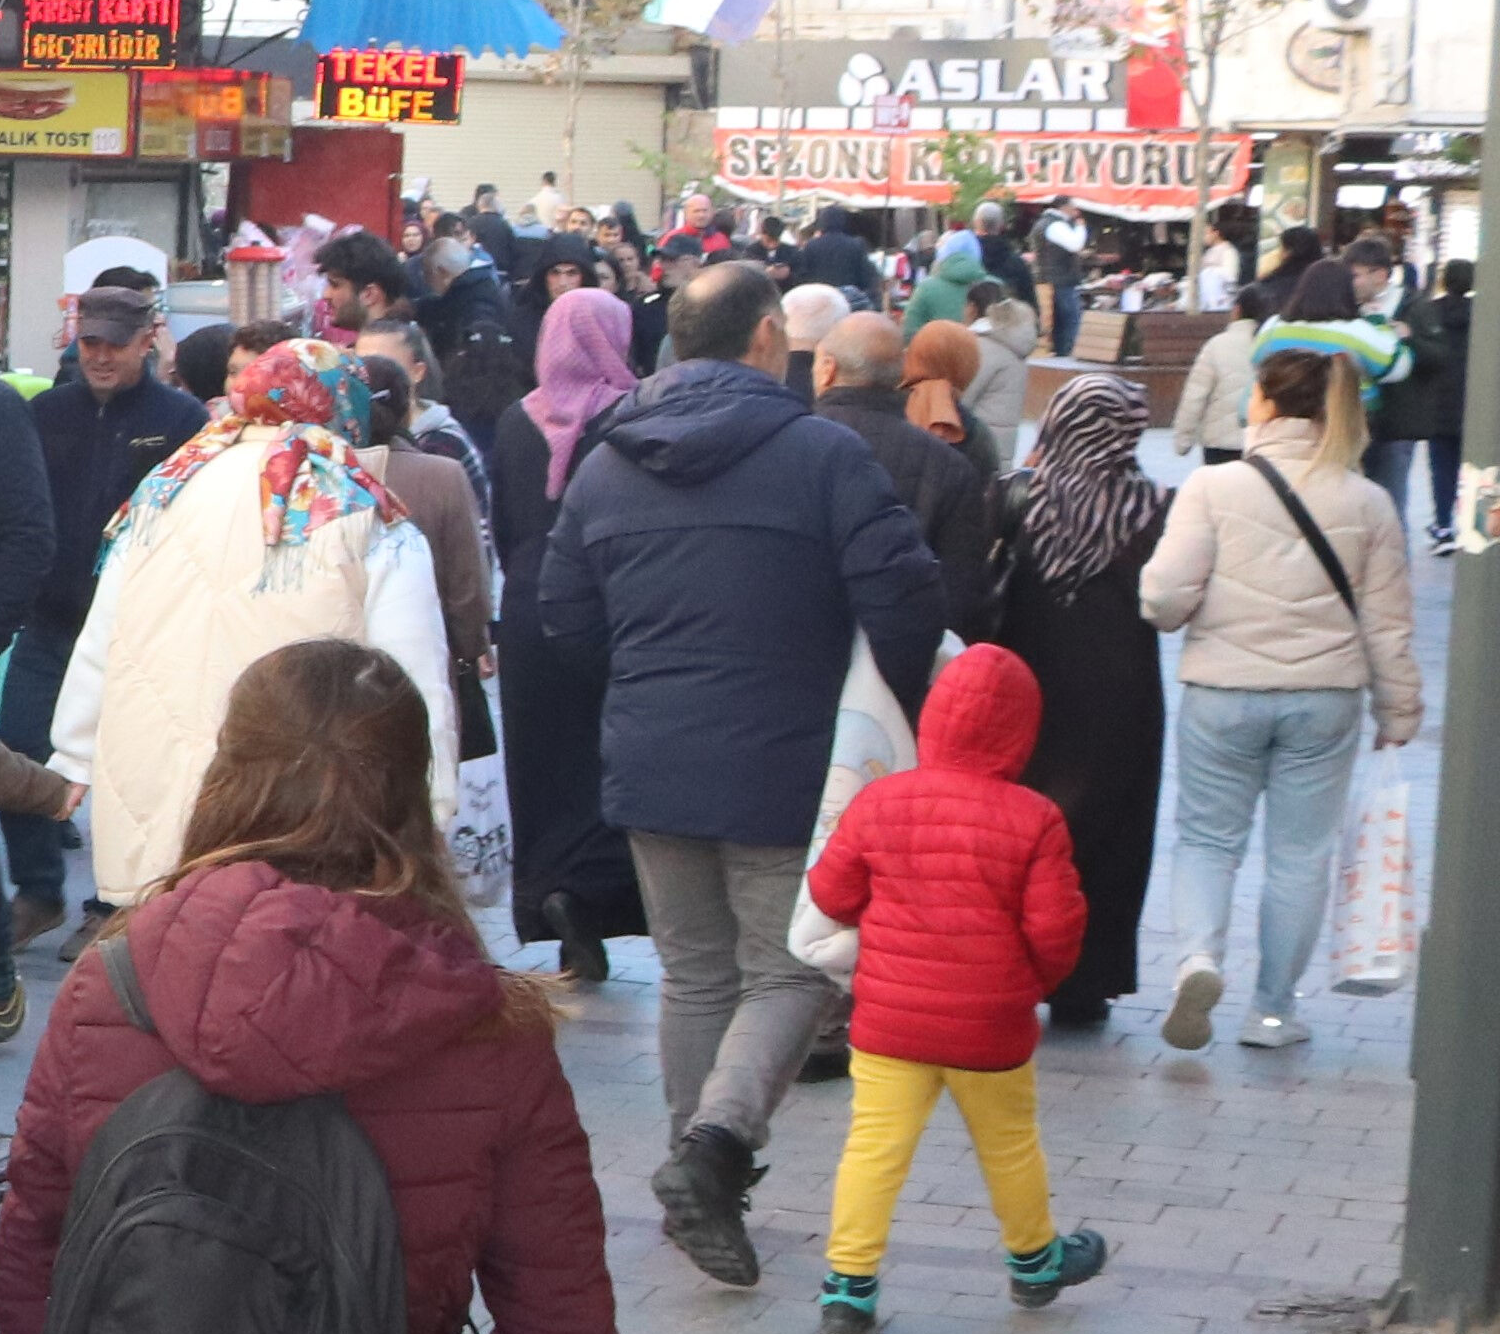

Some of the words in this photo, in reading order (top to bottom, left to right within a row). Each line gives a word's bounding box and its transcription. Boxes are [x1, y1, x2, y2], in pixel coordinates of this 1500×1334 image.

[330, 47, 449, 86] TEKEL
[46, 131, 91, 147] TOST
[727, 136, 891, 183] SEZONU
